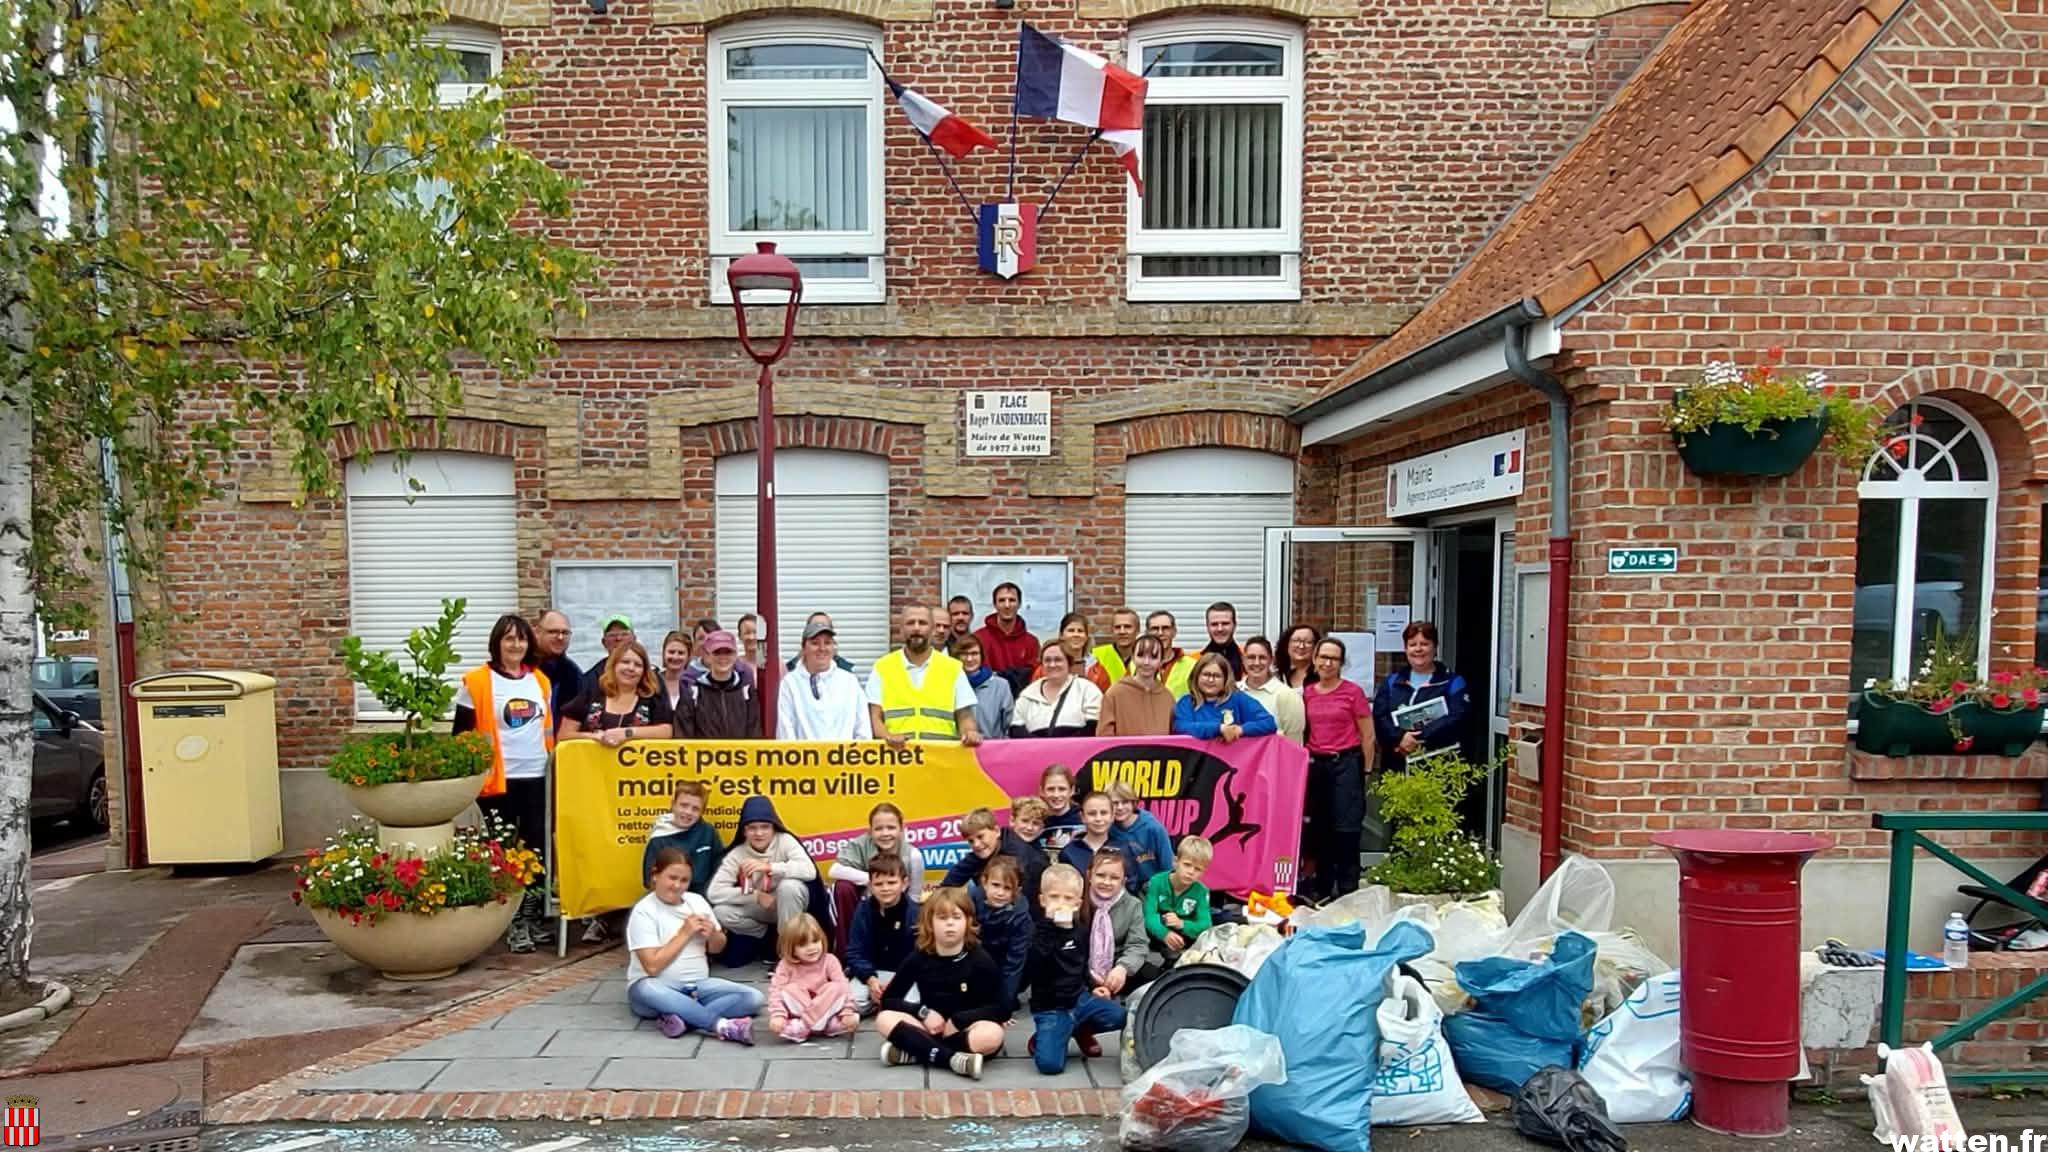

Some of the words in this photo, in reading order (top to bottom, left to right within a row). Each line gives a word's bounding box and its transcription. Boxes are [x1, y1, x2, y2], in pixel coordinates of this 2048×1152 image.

[1000, 395, 1028, 408] PLACE
[969, 413, 989, 428] Roger
[971, 432, 998, 441] Maire
[1000, 433, 1010, 441] de
[1013, 432, 1047, 441] Watten
[990, 444, 1010, 452] 1977
[1407, 464, 1432, 488] Mairie
[1629, 554, 1657, 566] DAE
[617, 746, 688, 767] C'est
[696, 749, 748, 774] pas
[756, 749, 819, 766] mon
[827, 742, 924, 766] déchet
[617, 773, 678, 796] mai
[770, 778, 816, 796] ma
[824, 772, 880, 796] ville
[1092, 759, 1182, 798] WORLD
[617, 807, 632, 817] La
